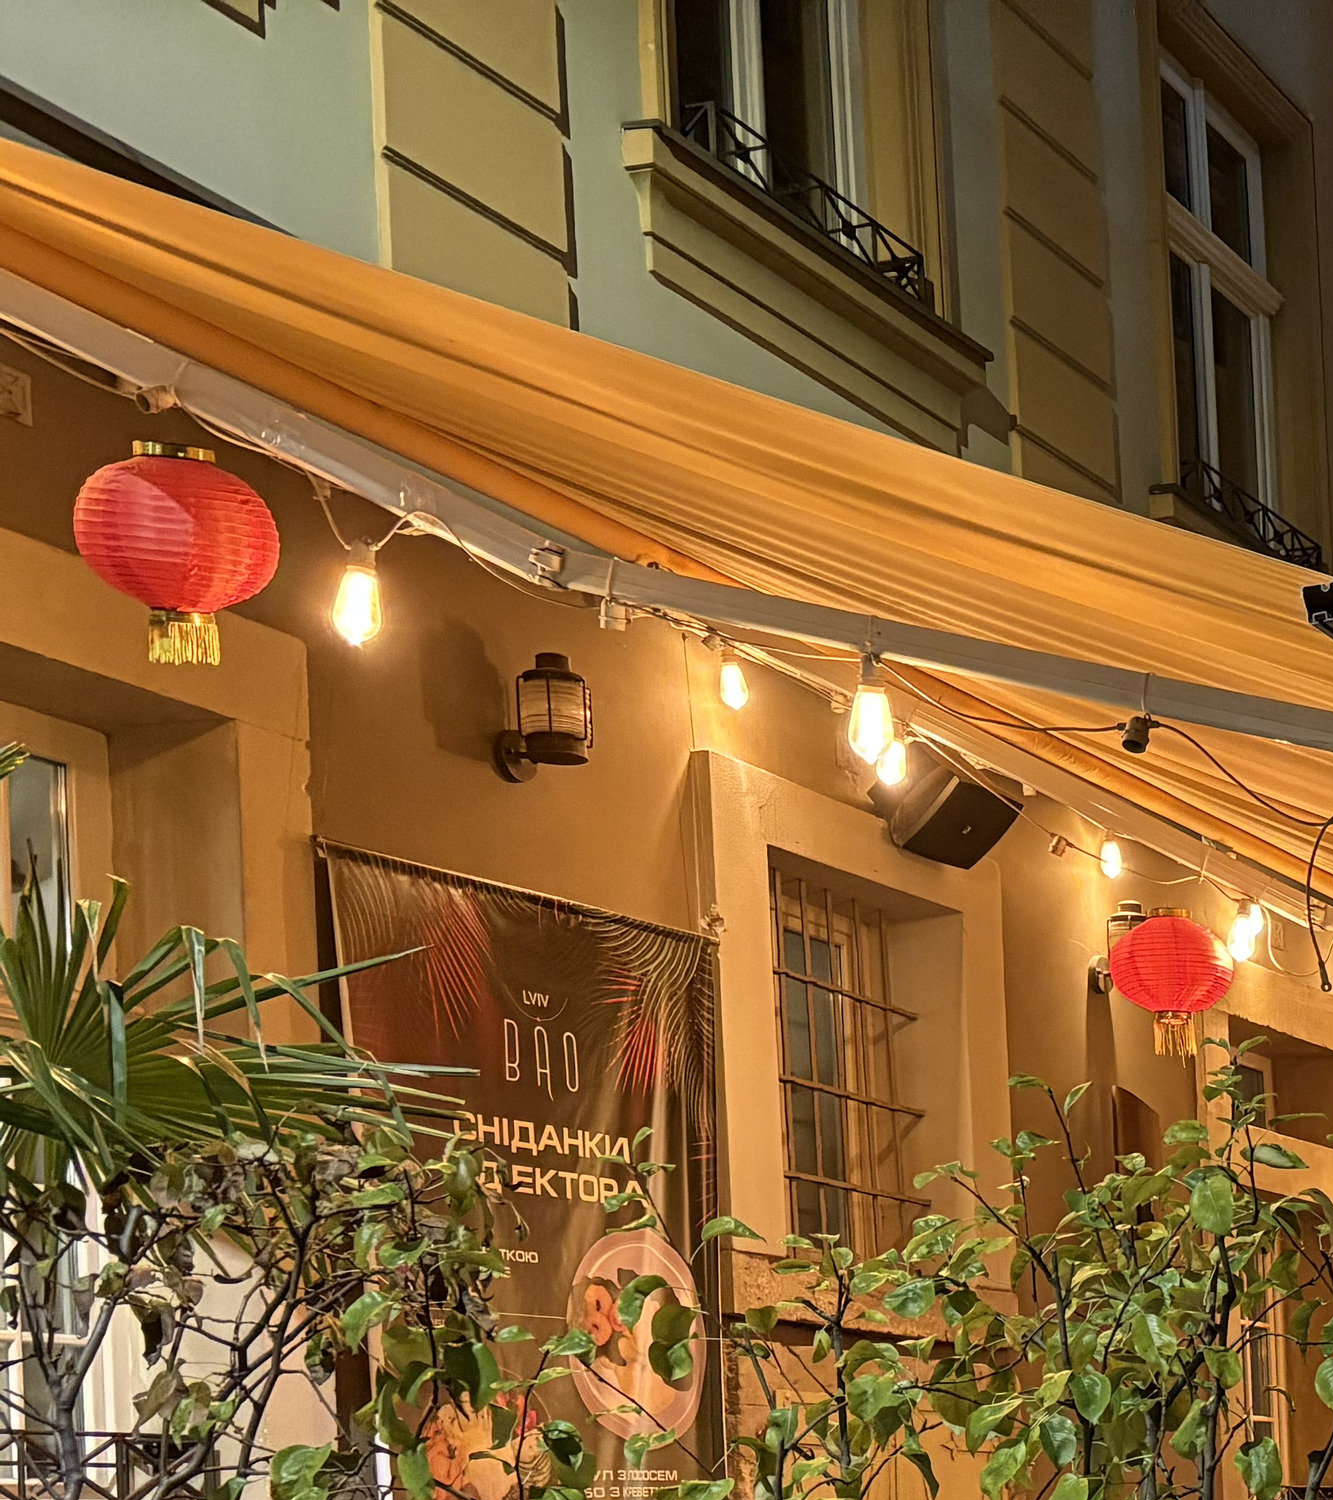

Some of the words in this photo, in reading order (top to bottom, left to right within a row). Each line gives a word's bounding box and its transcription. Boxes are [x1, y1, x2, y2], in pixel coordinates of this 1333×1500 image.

[523, 990, 549, 1007] LVIV
[504, 1018, 579, 1101] BAO
[453, 1111, 631, 1164] СНІДАНКИ
